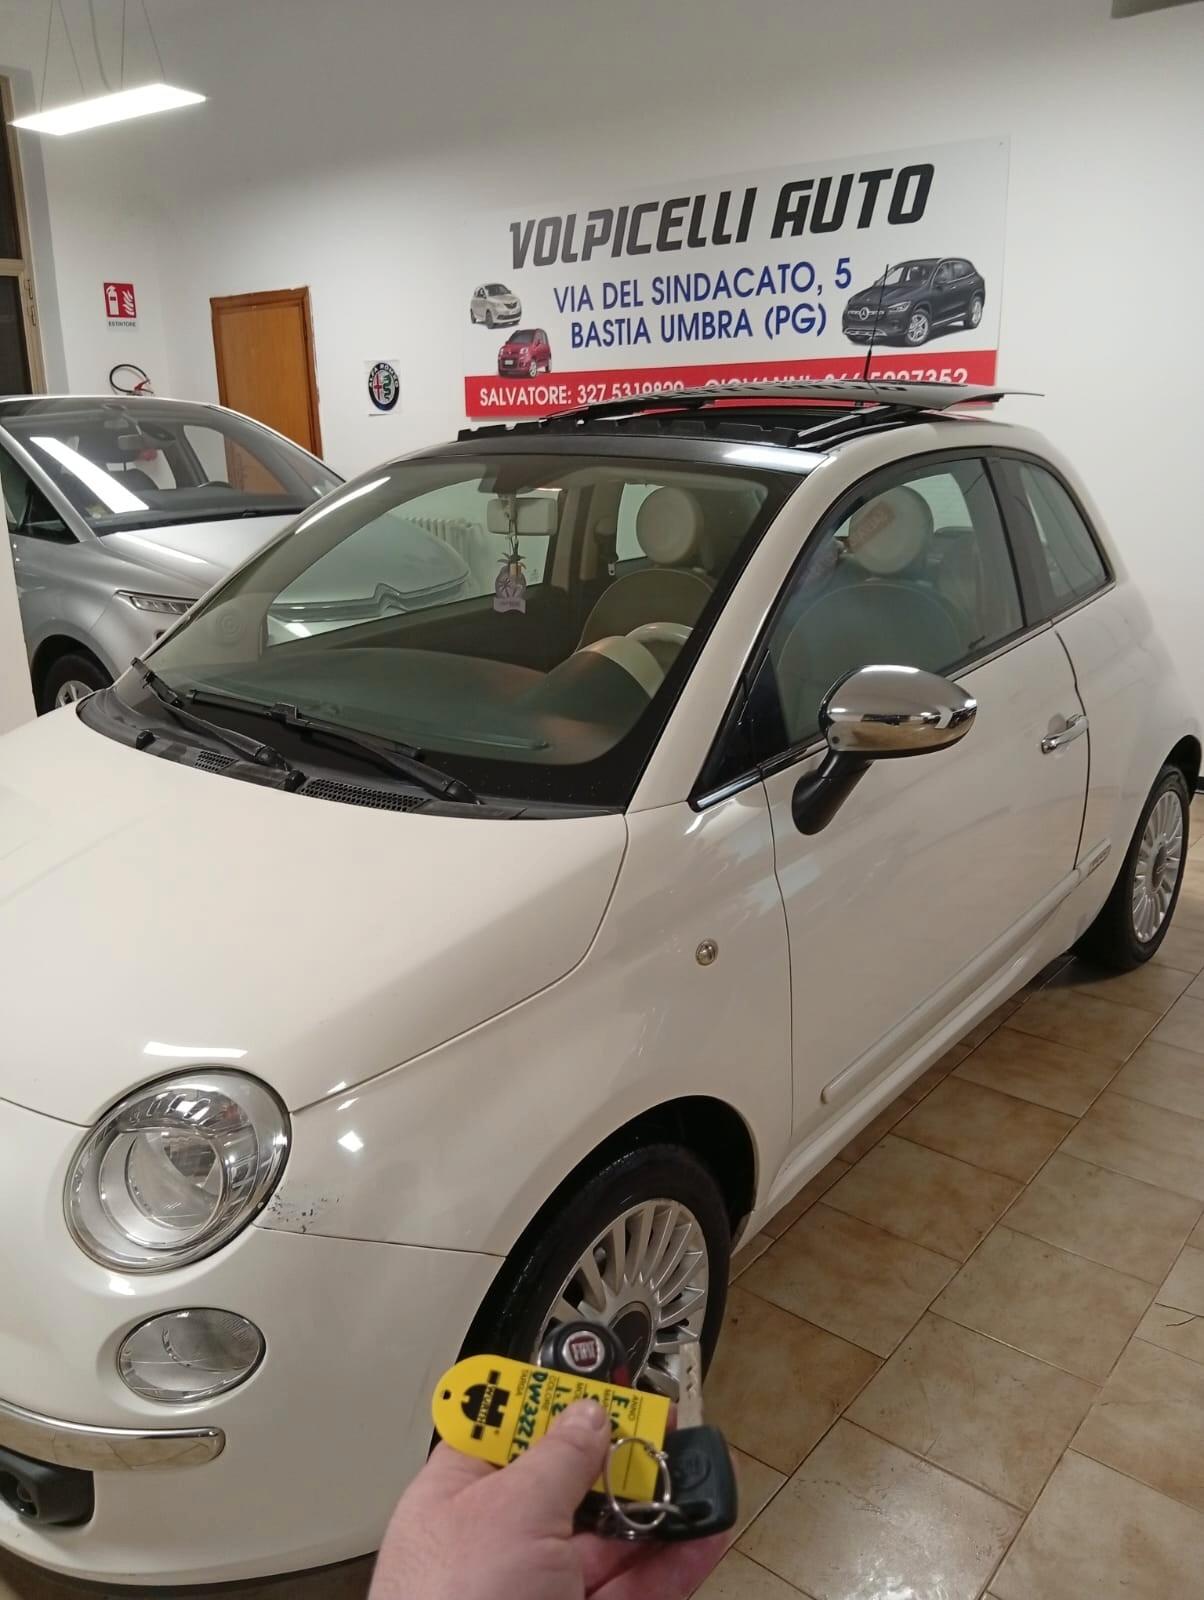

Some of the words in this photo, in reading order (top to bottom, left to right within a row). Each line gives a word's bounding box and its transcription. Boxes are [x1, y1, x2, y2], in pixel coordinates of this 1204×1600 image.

[510, 187, 757, 269] VOLPICELLI
[770, 163, 935, 240] AUTO
[553, 281, 594, 314] VIA
[602, 279, 644, 310] DEL
[651, 265, 824, 306] SINDACATO,
[835, 257, 852, 288] 5
[571, 316, 653, 349] BASTIA
[660, 308, 753, 342] UMBRA
[764, 305, 827, 339] (PG)
[479, 385, 572, 406] SALVATORE:
[571, 1340, 596, 1362] FIAT
[541, 1374, 556, 1411] COLORE
[628, 1394, 639, 1421] ANNO
